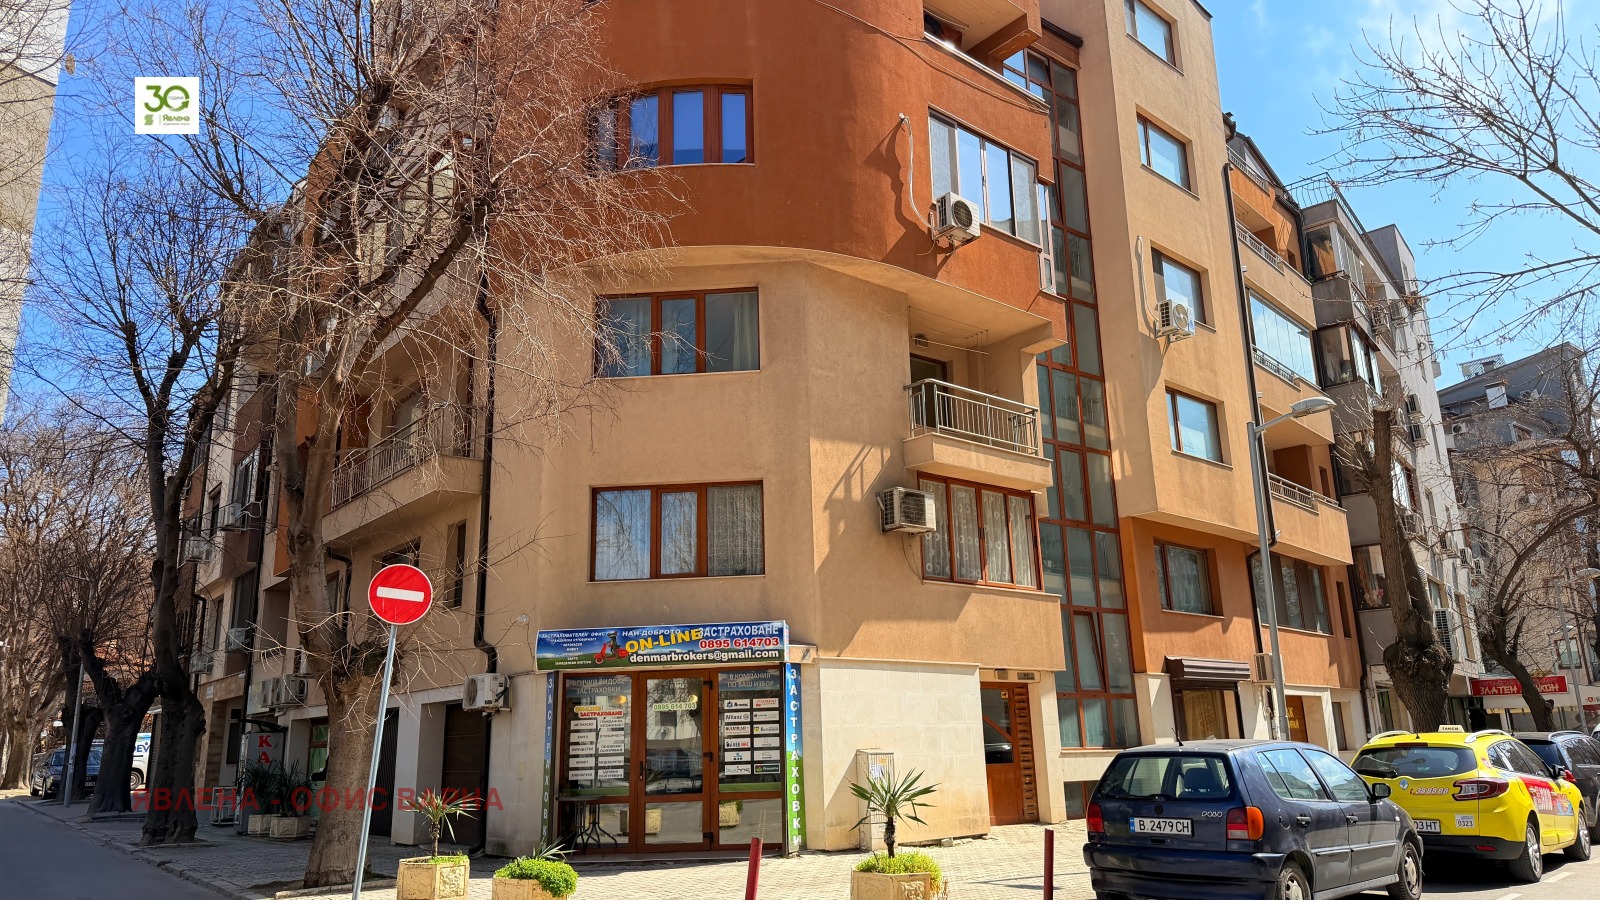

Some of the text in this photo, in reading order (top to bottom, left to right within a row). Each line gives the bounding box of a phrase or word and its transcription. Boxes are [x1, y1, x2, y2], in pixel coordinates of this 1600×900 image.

[699, 625, 779, 637] ЗАСТРАХОВАНЕ
[625, 628, 703, 653] ON-LINE
[699, 637, 780, 649] 0895 614703
[630, 649, 779, 663] denmarbrokers@gmail.com
[576, 686, 621, 694] ЗАСТРАХОВКИ
[1480, 685, 1518, 694] ЗЛАТЕН
[790, 668, 801, 846] ЗАСТРАХОВКИ
